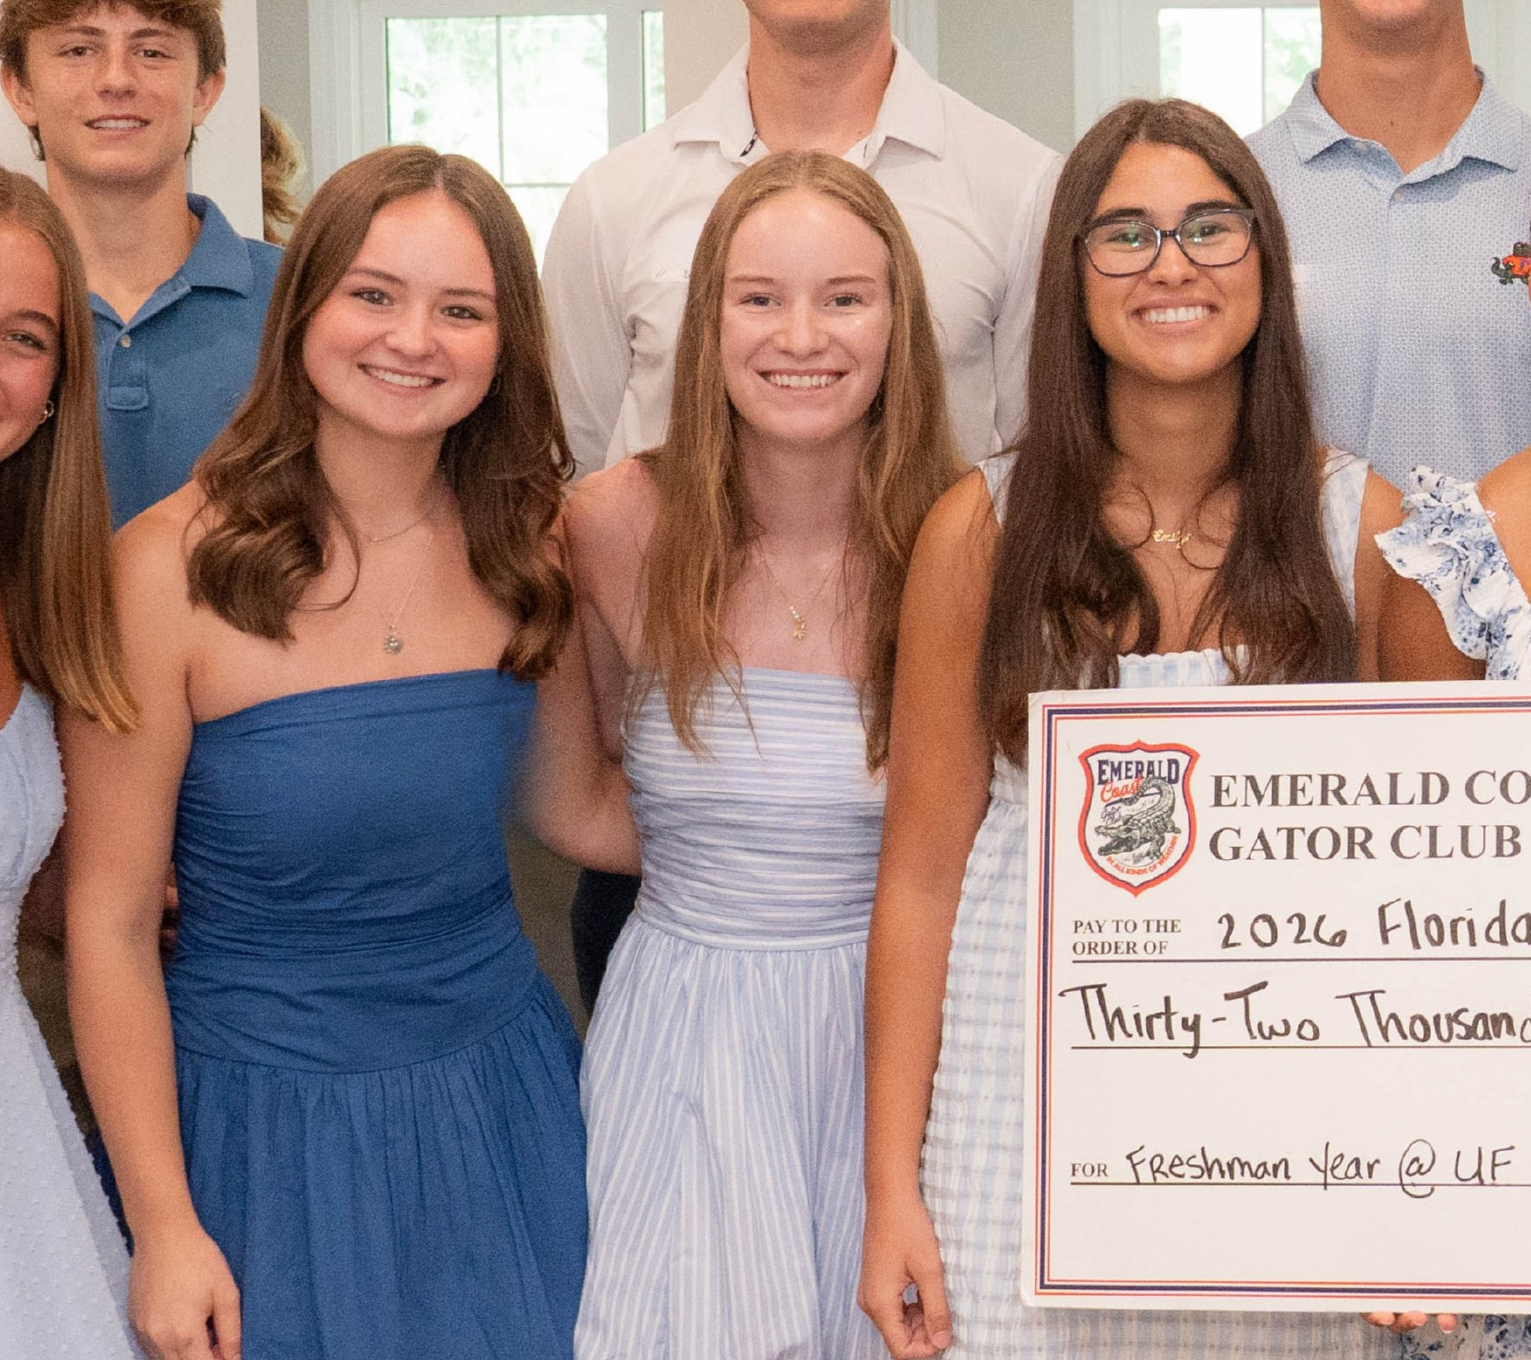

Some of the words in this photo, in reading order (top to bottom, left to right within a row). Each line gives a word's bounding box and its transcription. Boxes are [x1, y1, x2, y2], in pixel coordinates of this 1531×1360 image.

[1097, 758, 1180, 786] EMERALD
[1100, 773, 1144, 803] Coast
[1209, 771, 1450, 808] EMERALD
[1208, 825, 1377, 861] GATOR
[1389, 824, 1523, 860] CLUB
[1072, 919, 1107, 934] PAY
[1111, 919, 1138, 934] TO
[1142, 919, 1182, 934] THE
[1217, 912, 1349, 950] 2026
[1072, 940, 1138, 956] ORDER
[1143, 940, 1168, 955] OF
[1057, 980, 1321, 1060] Thirty-Two
[1071, 1162, 1109, 1178] FOR
[1399, 1138, 1436, 1199] @
[1454, 1145, 1516, 1185] UF
